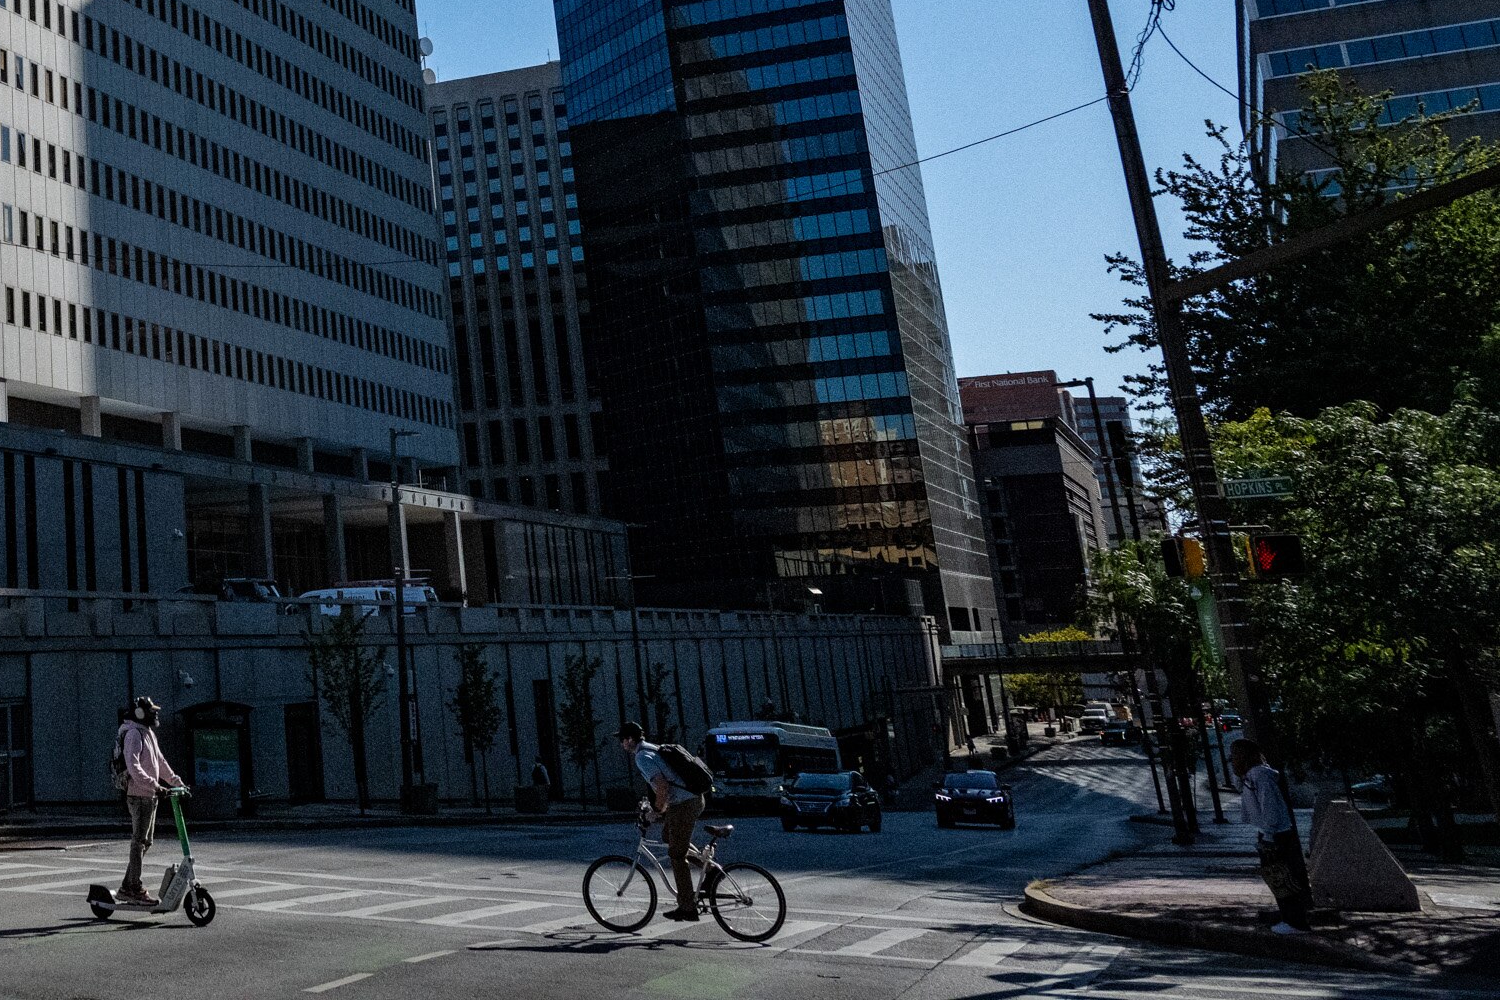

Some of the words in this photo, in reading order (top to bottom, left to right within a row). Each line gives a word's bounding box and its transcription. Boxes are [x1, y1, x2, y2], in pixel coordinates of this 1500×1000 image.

[974, 380, 991, 389] First
[991, 377, 1026, 387] National
[1026, 375, 1049, 384] Bank
[1226, 481, 1273, 496] HOPKINS
[1211, 646, 1220, 664] CITY
